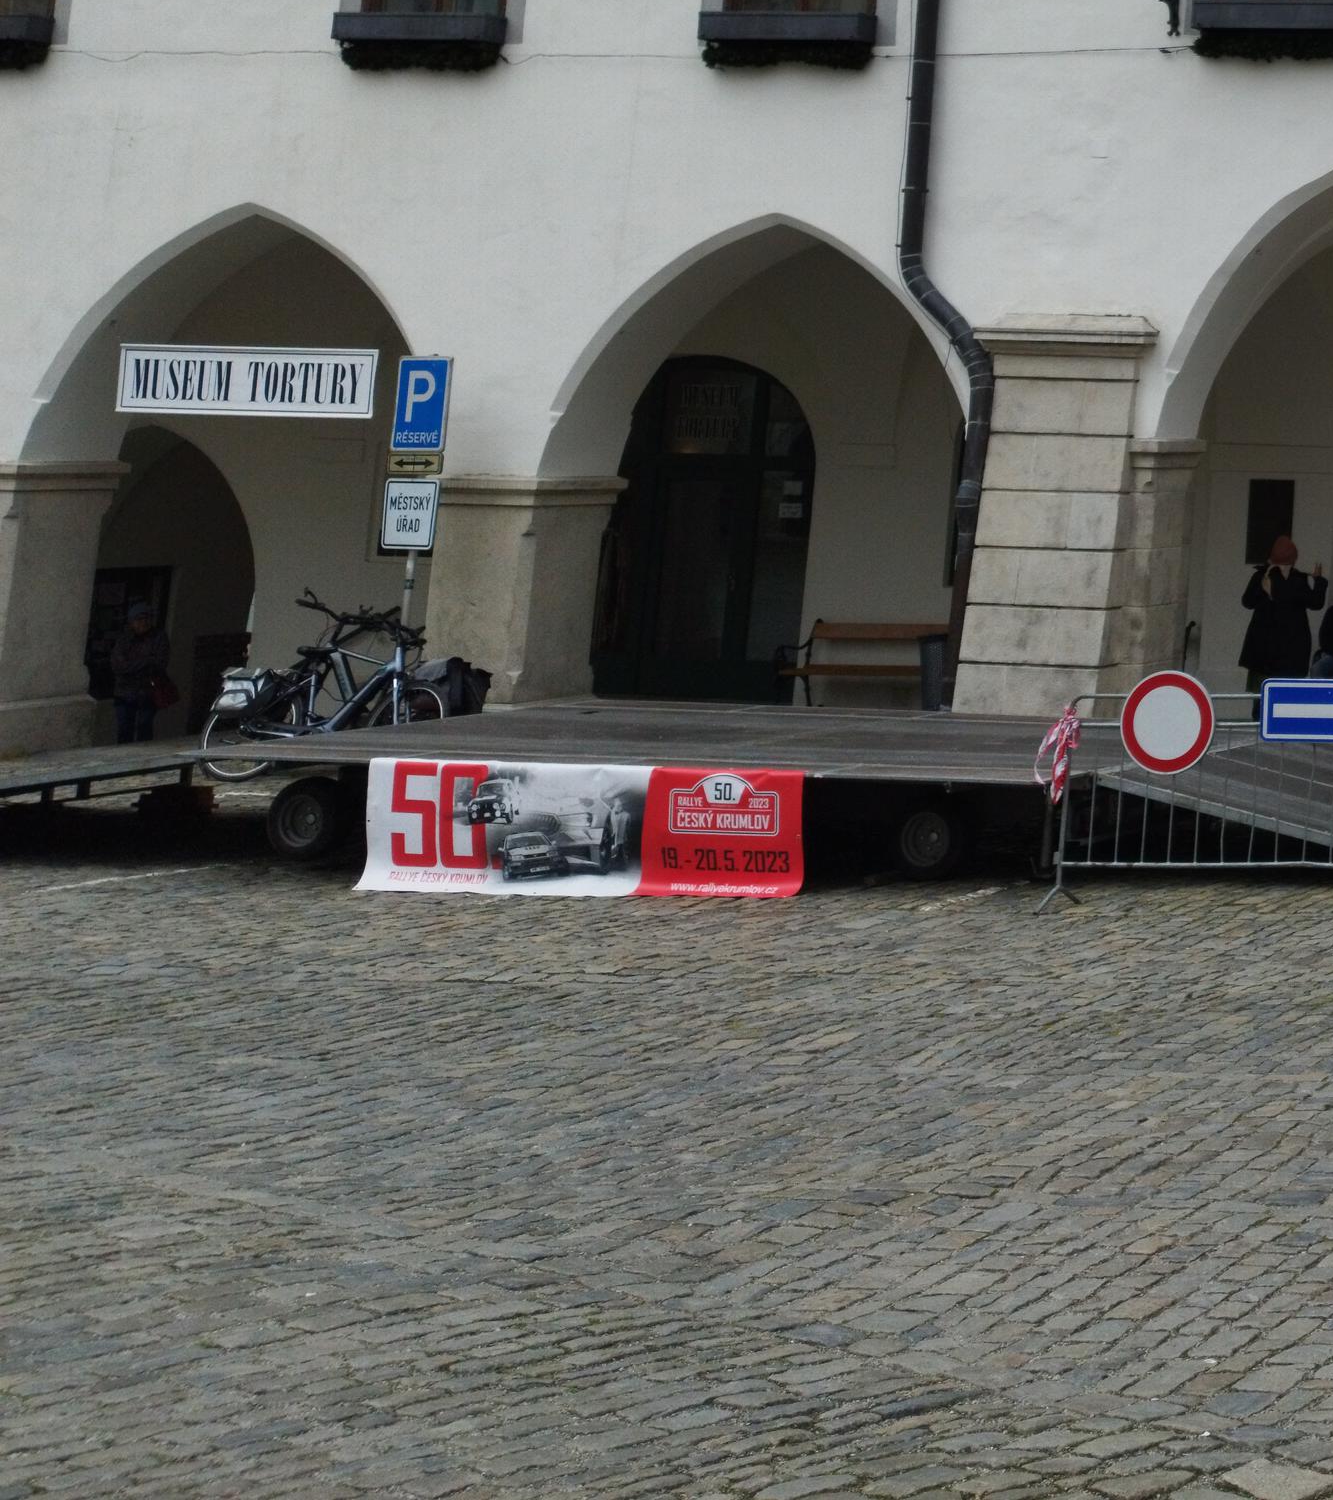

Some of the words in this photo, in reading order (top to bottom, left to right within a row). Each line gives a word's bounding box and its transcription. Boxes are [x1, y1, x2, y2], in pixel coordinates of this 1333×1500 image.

[131, 358, 233, 401] MUSEUM
[248, 361, 365, 405] TORTURY
[404, 370, 436, 422] P
[396, 514, 421, 533] ÚŘAD
[714, 782, 736, 801] 50.
[677, 796, 703, 807] RALLYE
[748, 797, 769, 808] 2023
[677, 809, 714, 828] ČESKÝ
[716, 812, 770, 830] KRUMLOV
[388, 870, 419, 882] RALLYE
[448, 873, 488, 884] KRUMLOV
[671, 882, 779, 895] www.rallyekrumlov.cz
